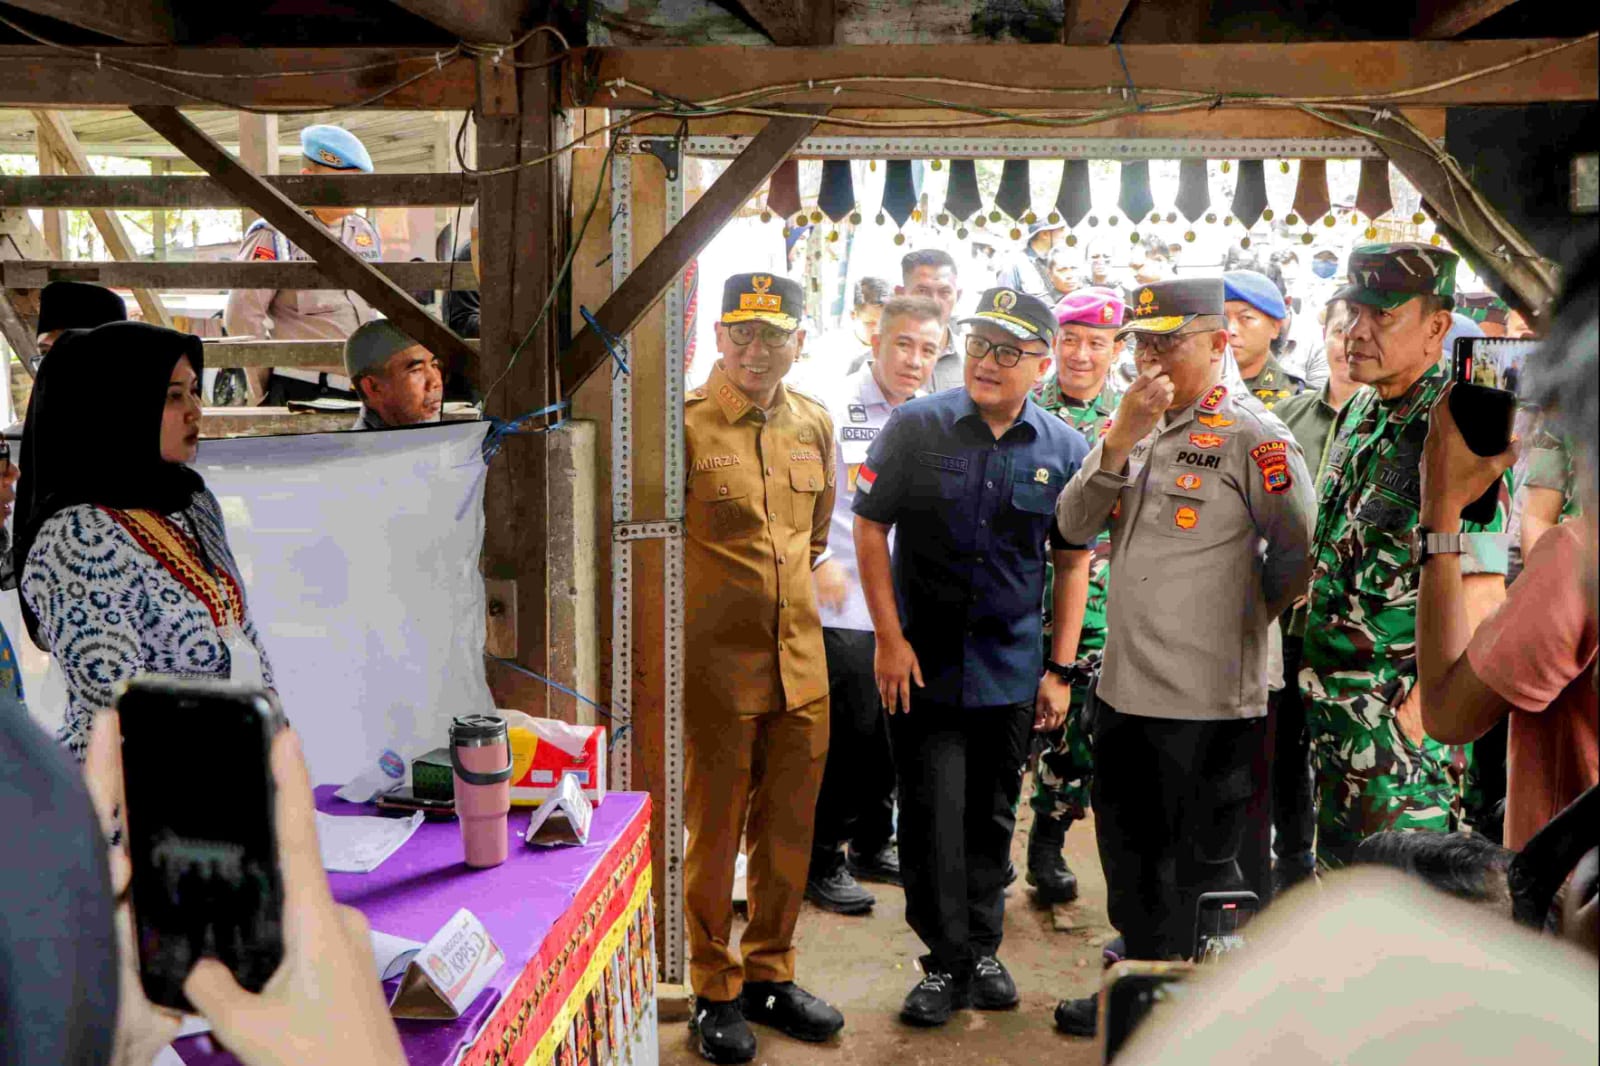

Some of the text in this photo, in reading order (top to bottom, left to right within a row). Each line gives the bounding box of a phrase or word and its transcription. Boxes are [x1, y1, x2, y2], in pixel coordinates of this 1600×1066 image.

[1253, 442, 1285, 458] POLDA
[696, 454, 741, 471] MIRZA
[1176, 451, 1221, 469] POLRI
[448, 940, 477, 975] KPPS
